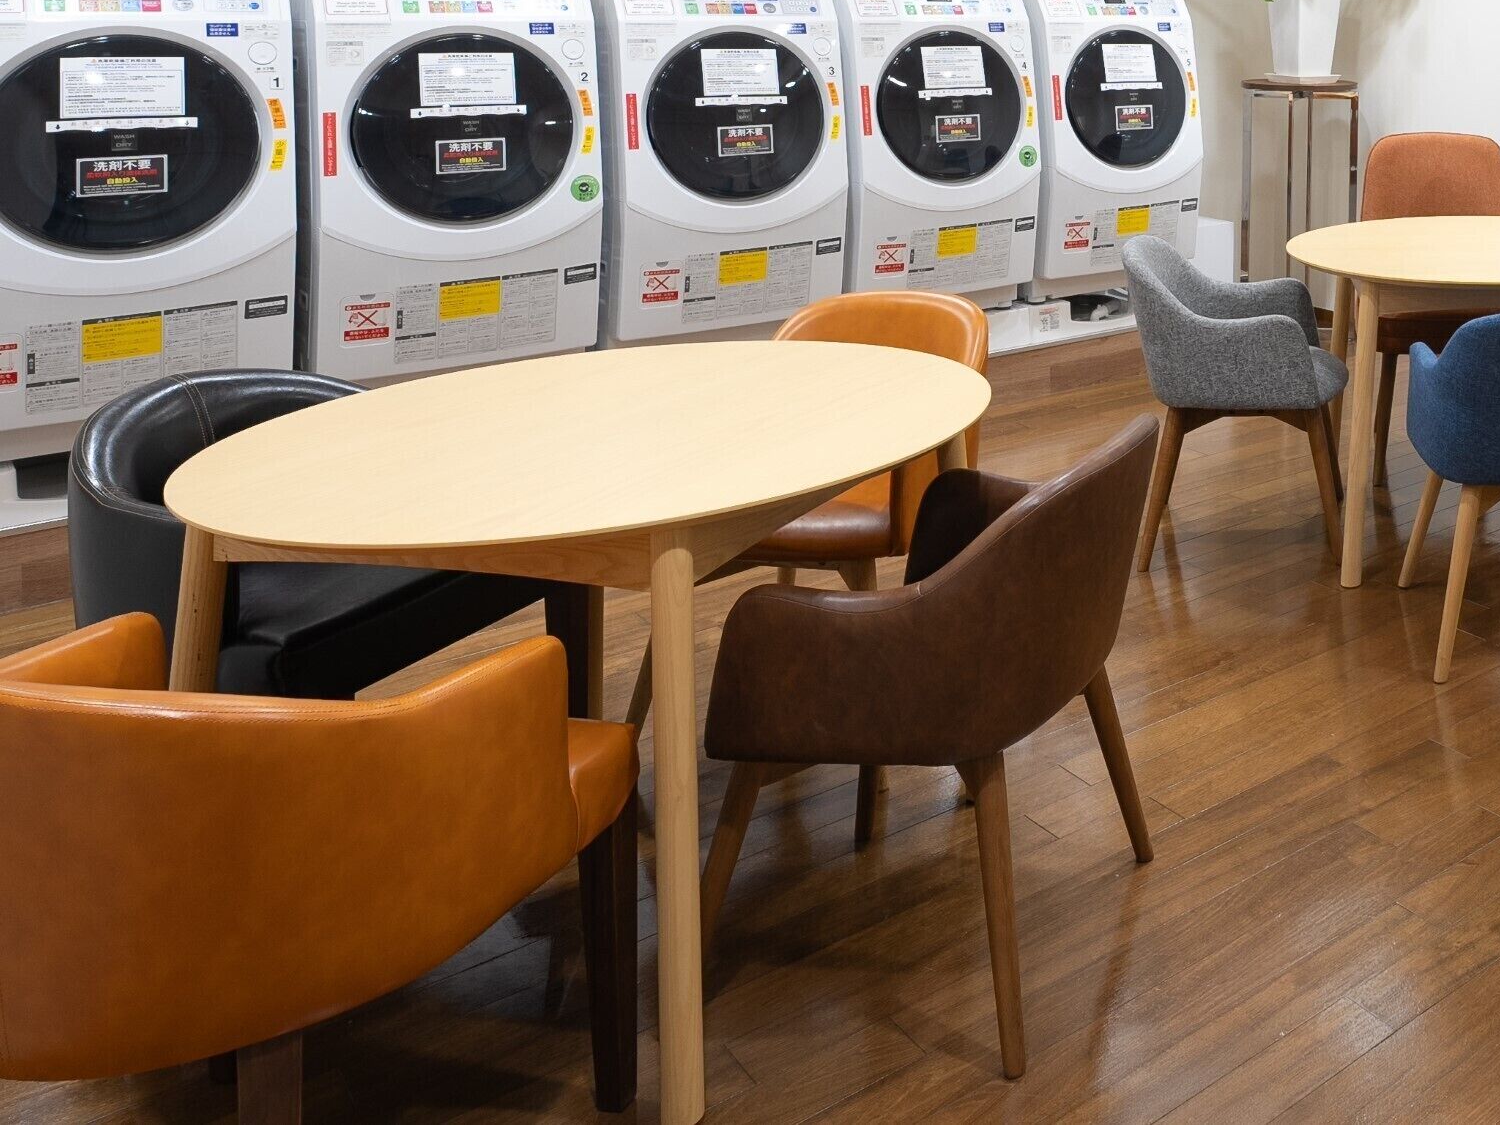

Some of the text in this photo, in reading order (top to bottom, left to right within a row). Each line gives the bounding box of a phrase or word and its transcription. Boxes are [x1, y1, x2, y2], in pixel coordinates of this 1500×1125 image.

[1021, 61, 1027, 70] 4
[1186, 58, 1192, 67] 5
[828, 66, 835, 76] 3
[581, 72, 589, 82] 2
[273, 77, 280, 88] 1
[944, 117, 972, 126] 洗剤不要
[728, 128, 764, 138] 洗剤不要
[449, 141, 494, 153] 洗剤不要
[93, 159, 152, 172] 洗剤不要
[107, 177, 138, 185] 自動投入
